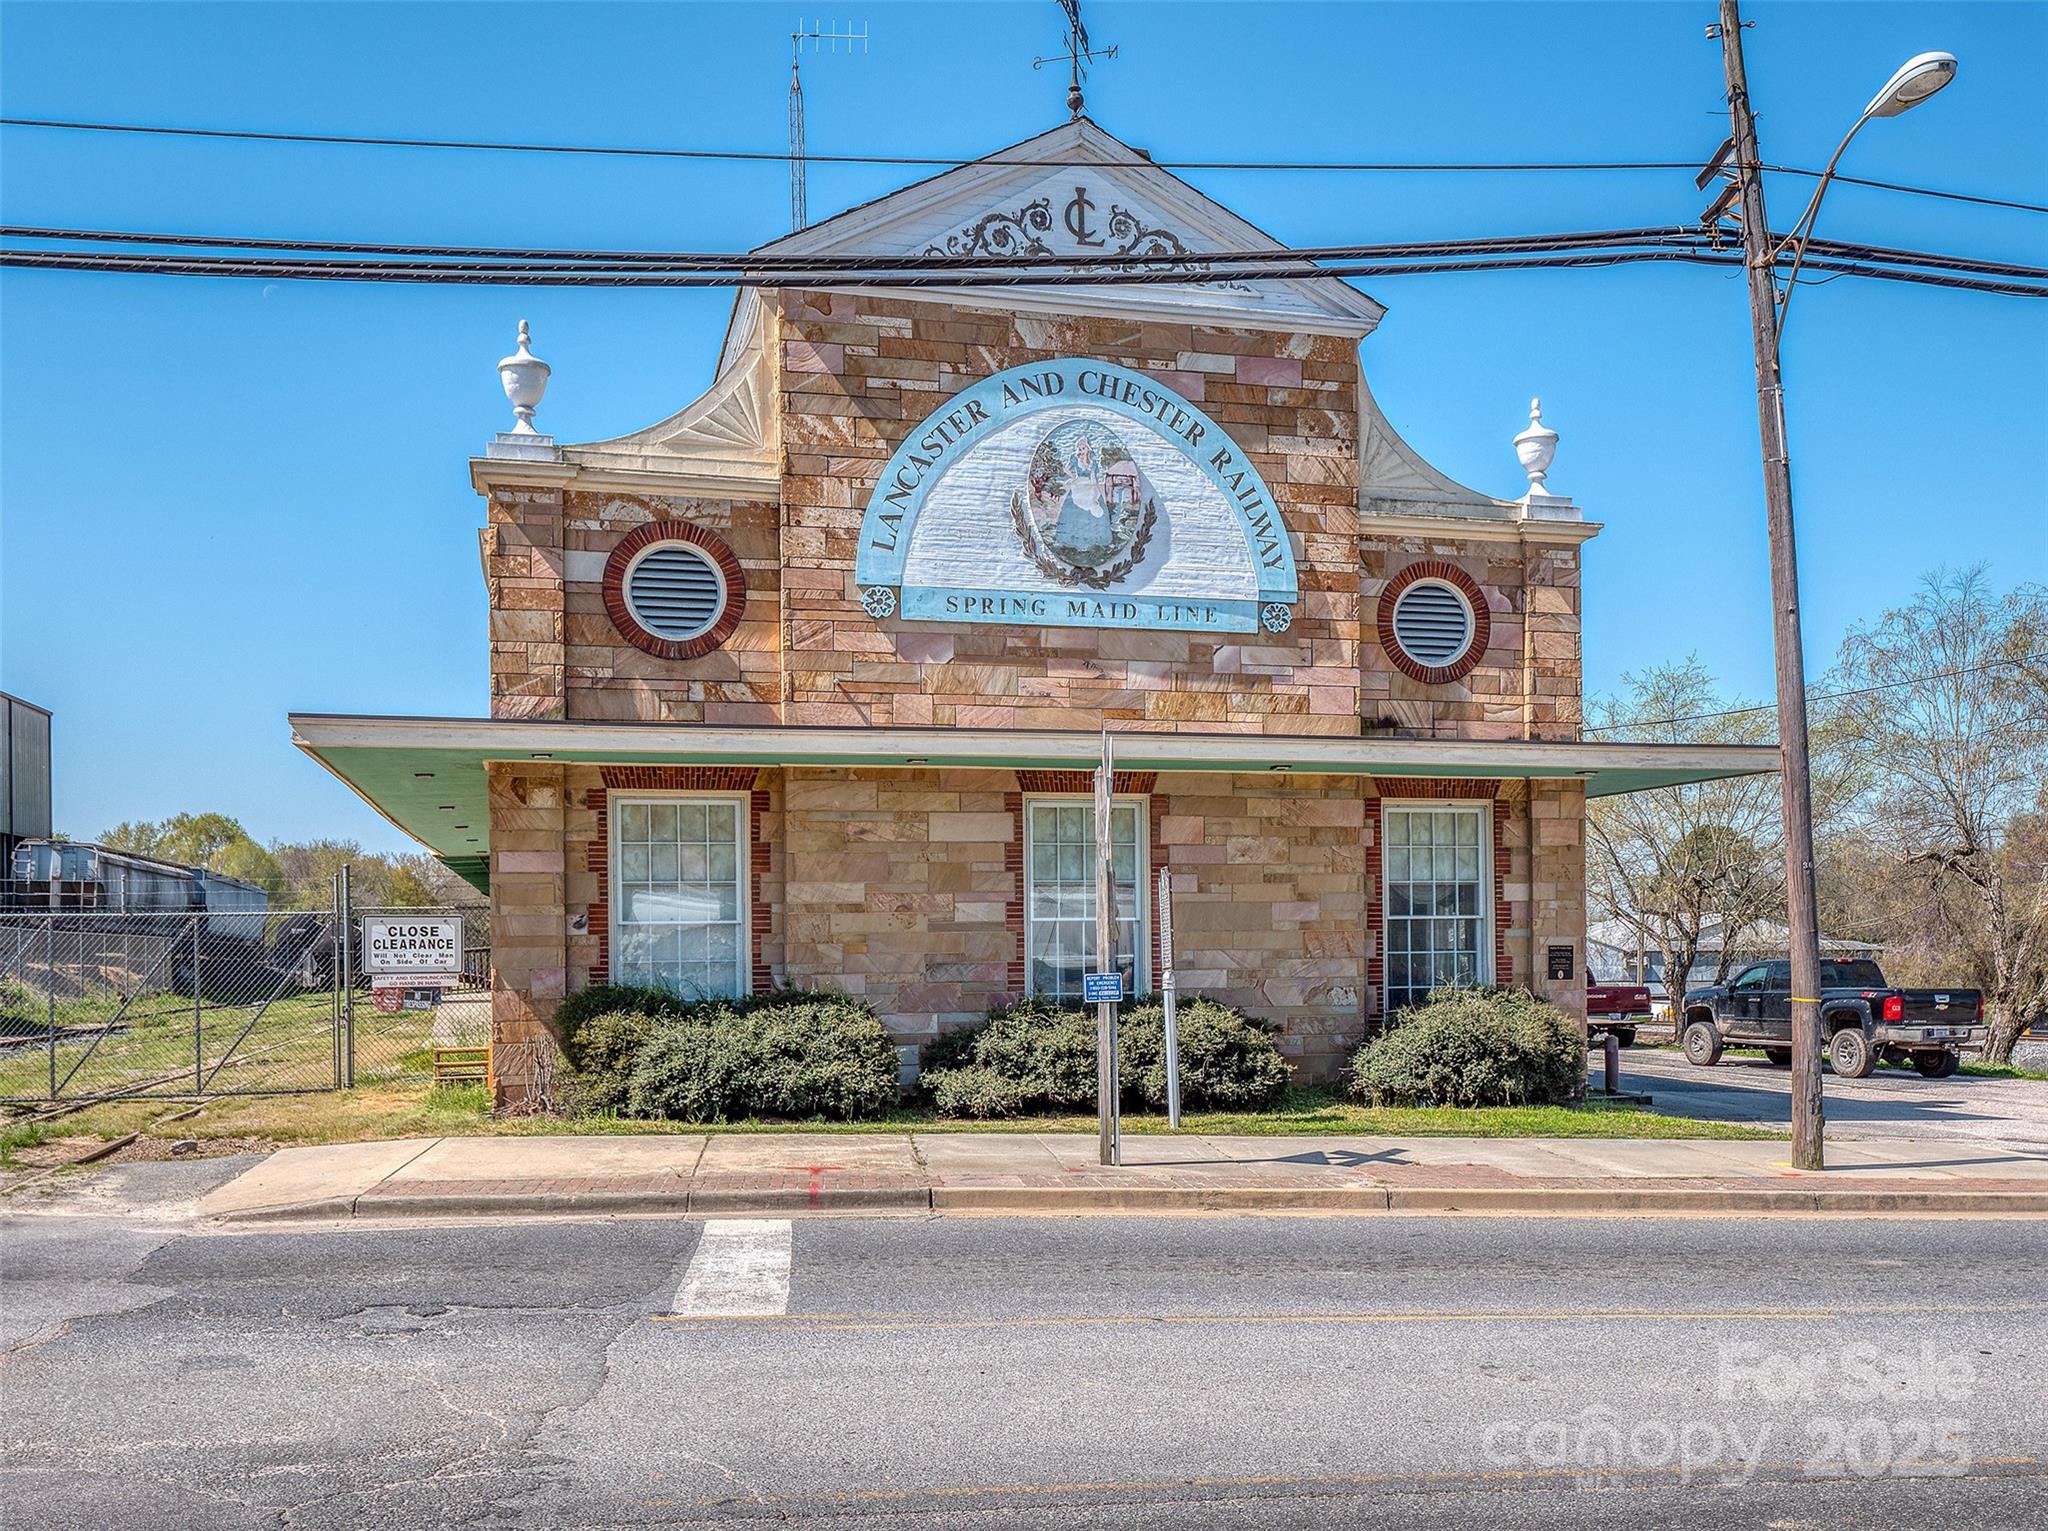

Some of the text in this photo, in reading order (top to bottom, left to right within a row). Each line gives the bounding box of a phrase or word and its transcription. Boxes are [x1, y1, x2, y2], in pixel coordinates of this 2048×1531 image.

[870, 370, 1286, 574] LANCASTER AND CHESTER RAILWAY
[946, 595, 1218, 624] SPRING MAID LINE
[388, 926, 439, 937] CLOSE
[373, 939, 454, 950] CLEARANCE
